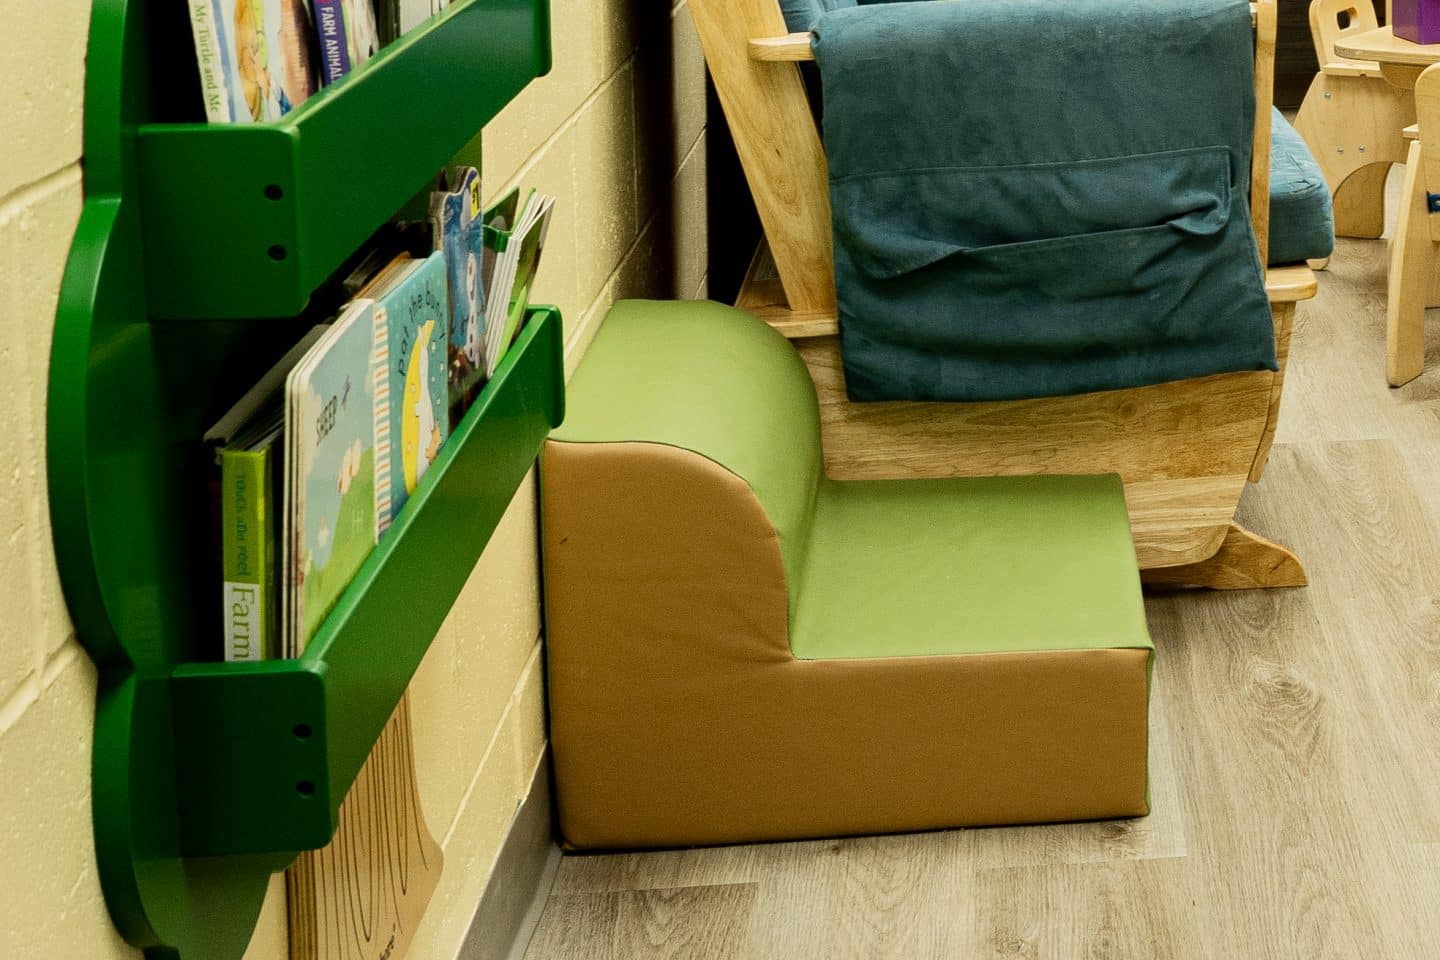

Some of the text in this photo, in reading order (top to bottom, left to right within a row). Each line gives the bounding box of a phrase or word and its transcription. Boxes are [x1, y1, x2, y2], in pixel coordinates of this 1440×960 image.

[320, 6, 337, 36] FARM
[194, 4, 222, 113] My Turtle and Me
[326, 39, 344, 83] ANIMAL
[408, 294, 423, 324] the
[425, 280, 446, 340] bunny
[232, 587, 255, 659] Farm
